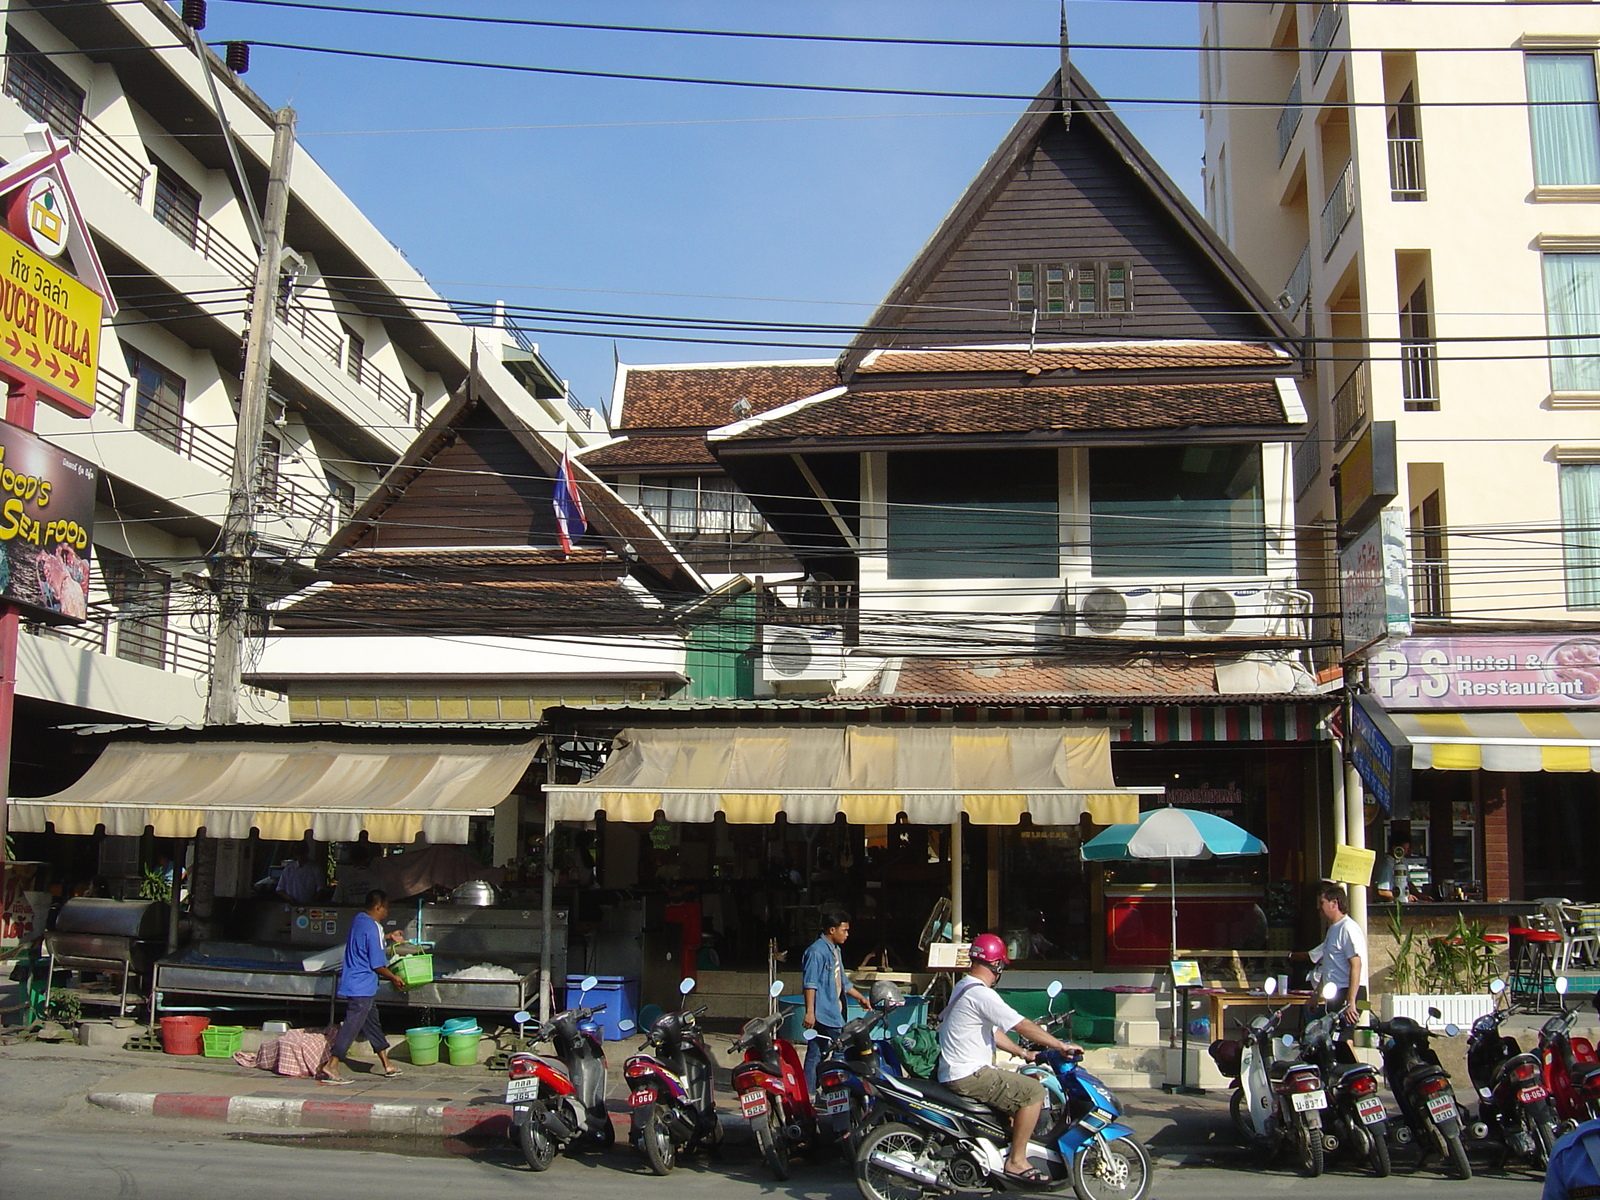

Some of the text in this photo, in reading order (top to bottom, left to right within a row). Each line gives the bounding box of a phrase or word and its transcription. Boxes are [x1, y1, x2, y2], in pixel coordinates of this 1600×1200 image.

[10, 249, 69, 310] ทัช วิลล่า
[43, 302, 92, 369] VILLA
[0, 462, 52, 507] OOD'S
[0, 498, 88, 549] SEA FOOD
[1378, 649, 1450, 699] P.S
[1456, 654, 1543, 672] Hotel &
[1457, 678, 1584, 697] Restaurant
[746, 1104, 764, 1117] 522
[832, 1104, 844, 1113] 27
[1435, 1109, 1453, 1121] 230
